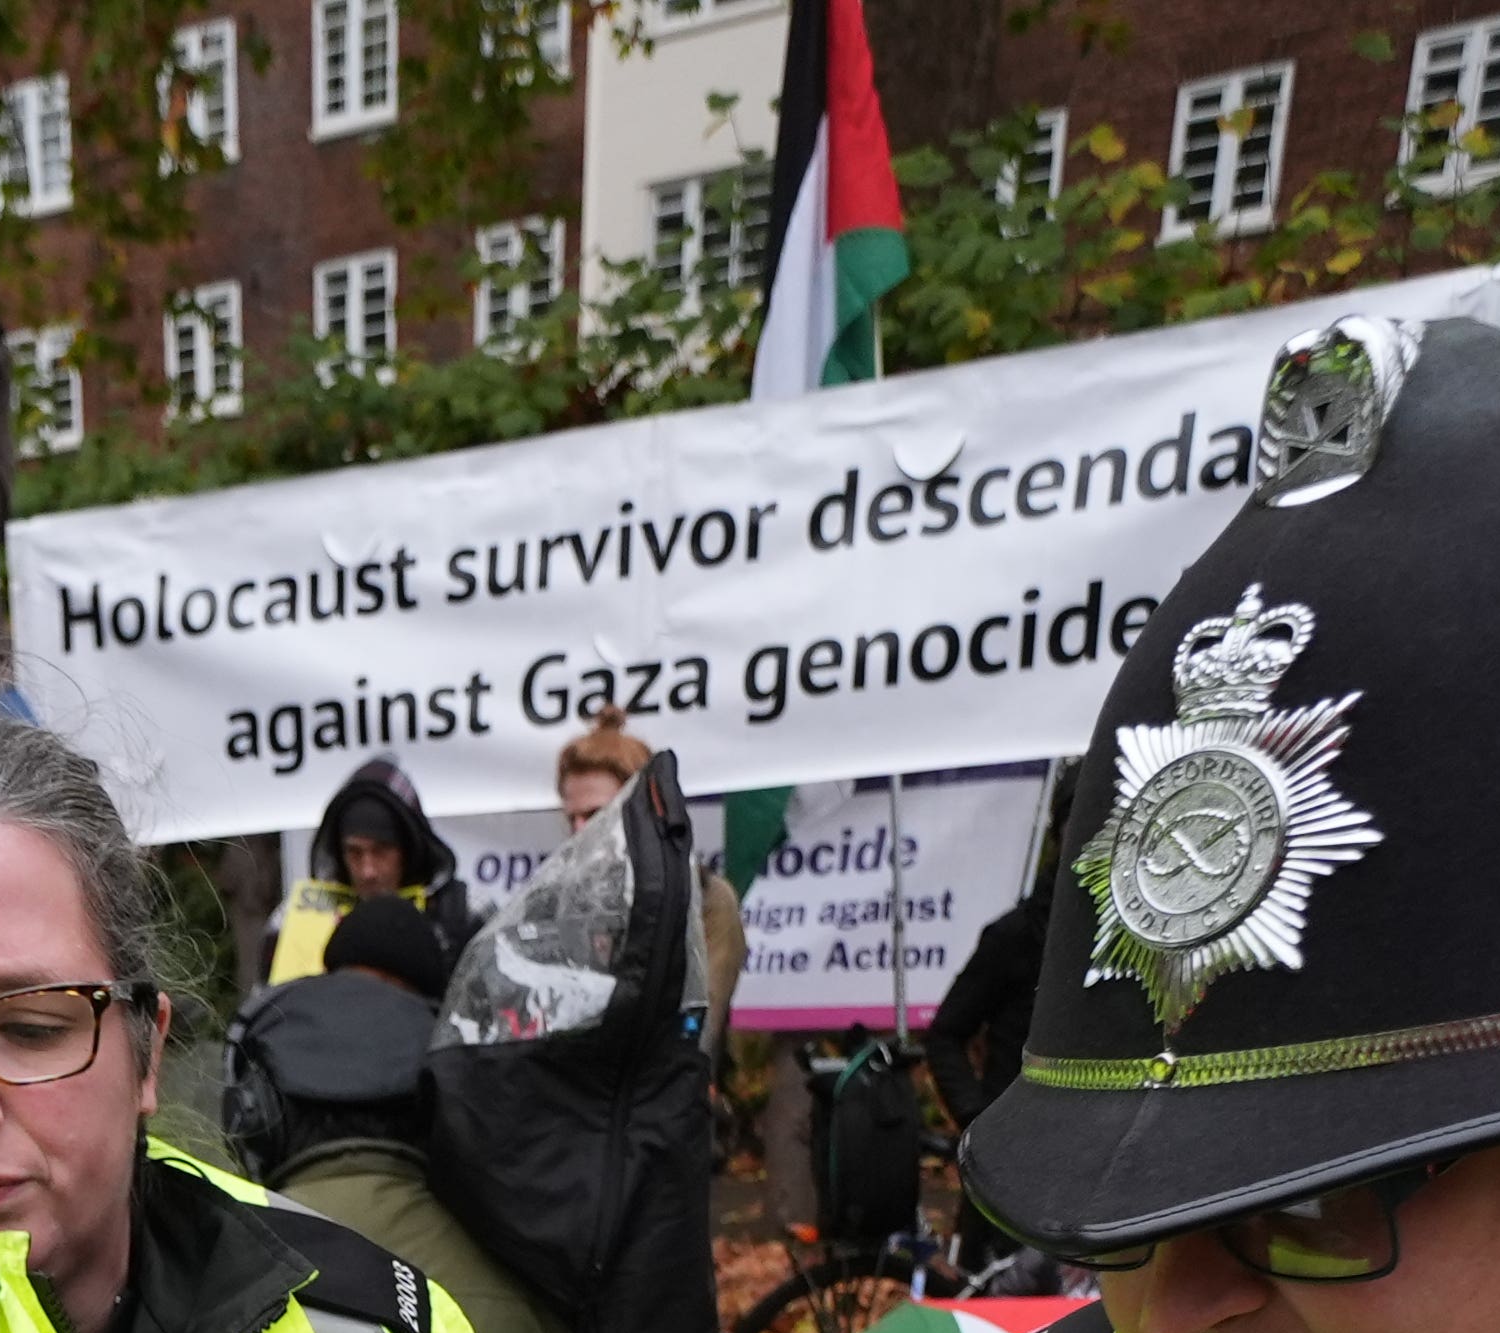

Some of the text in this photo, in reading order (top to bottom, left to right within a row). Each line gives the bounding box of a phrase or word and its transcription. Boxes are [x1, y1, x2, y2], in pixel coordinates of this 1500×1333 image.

[58, 411, 1254, 654] Holocaust survivor descenda
[226, 580, 1164, 776] against Gaza genocide
[1124, 887, 1243, 940] POLICE
[391, 1259, 420, 1333] 26003
